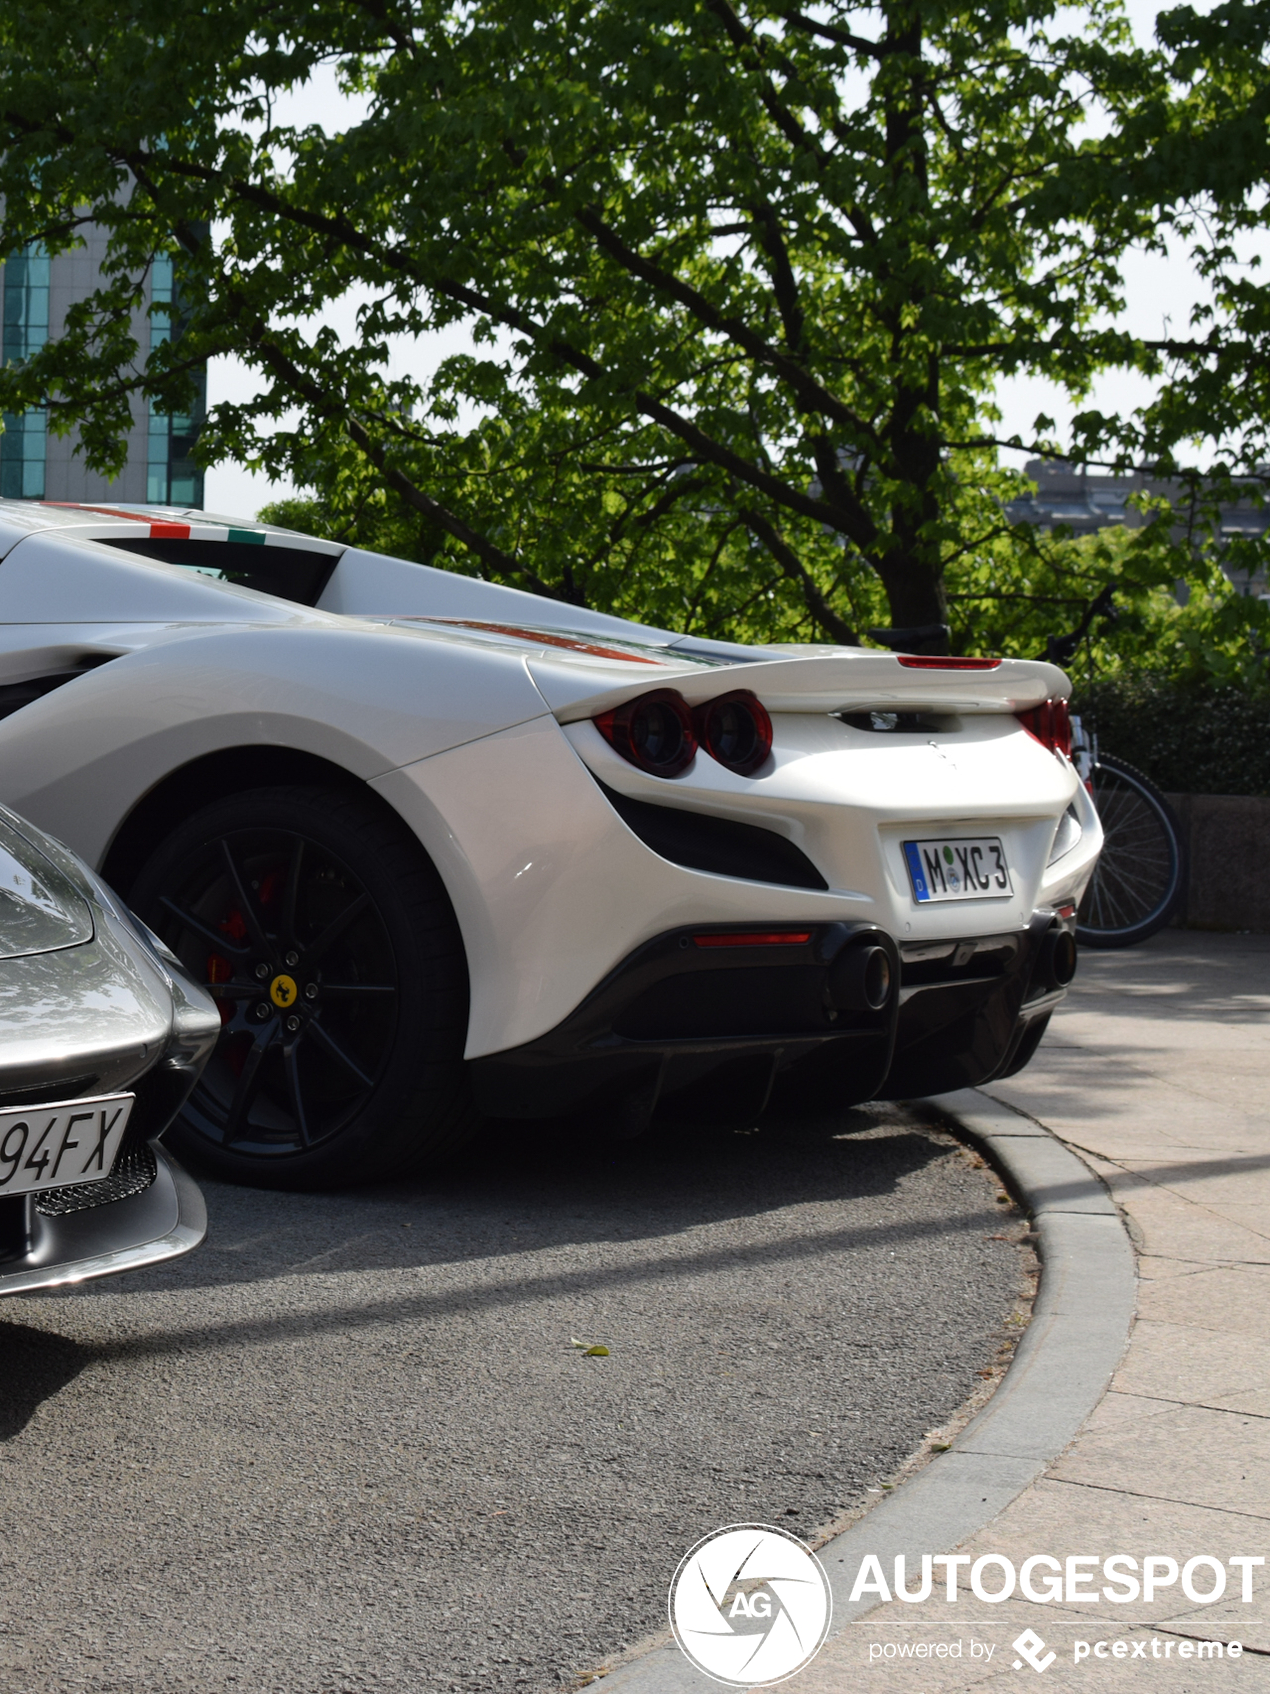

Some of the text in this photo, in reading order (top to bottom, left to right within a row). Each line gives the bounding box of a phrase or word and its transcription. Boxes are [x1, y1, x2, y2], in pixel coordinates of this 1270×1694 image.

[923, 848, 947, 893] M
[988, 846, 1007, 889] 3
[916, 879, 924, 892] D
